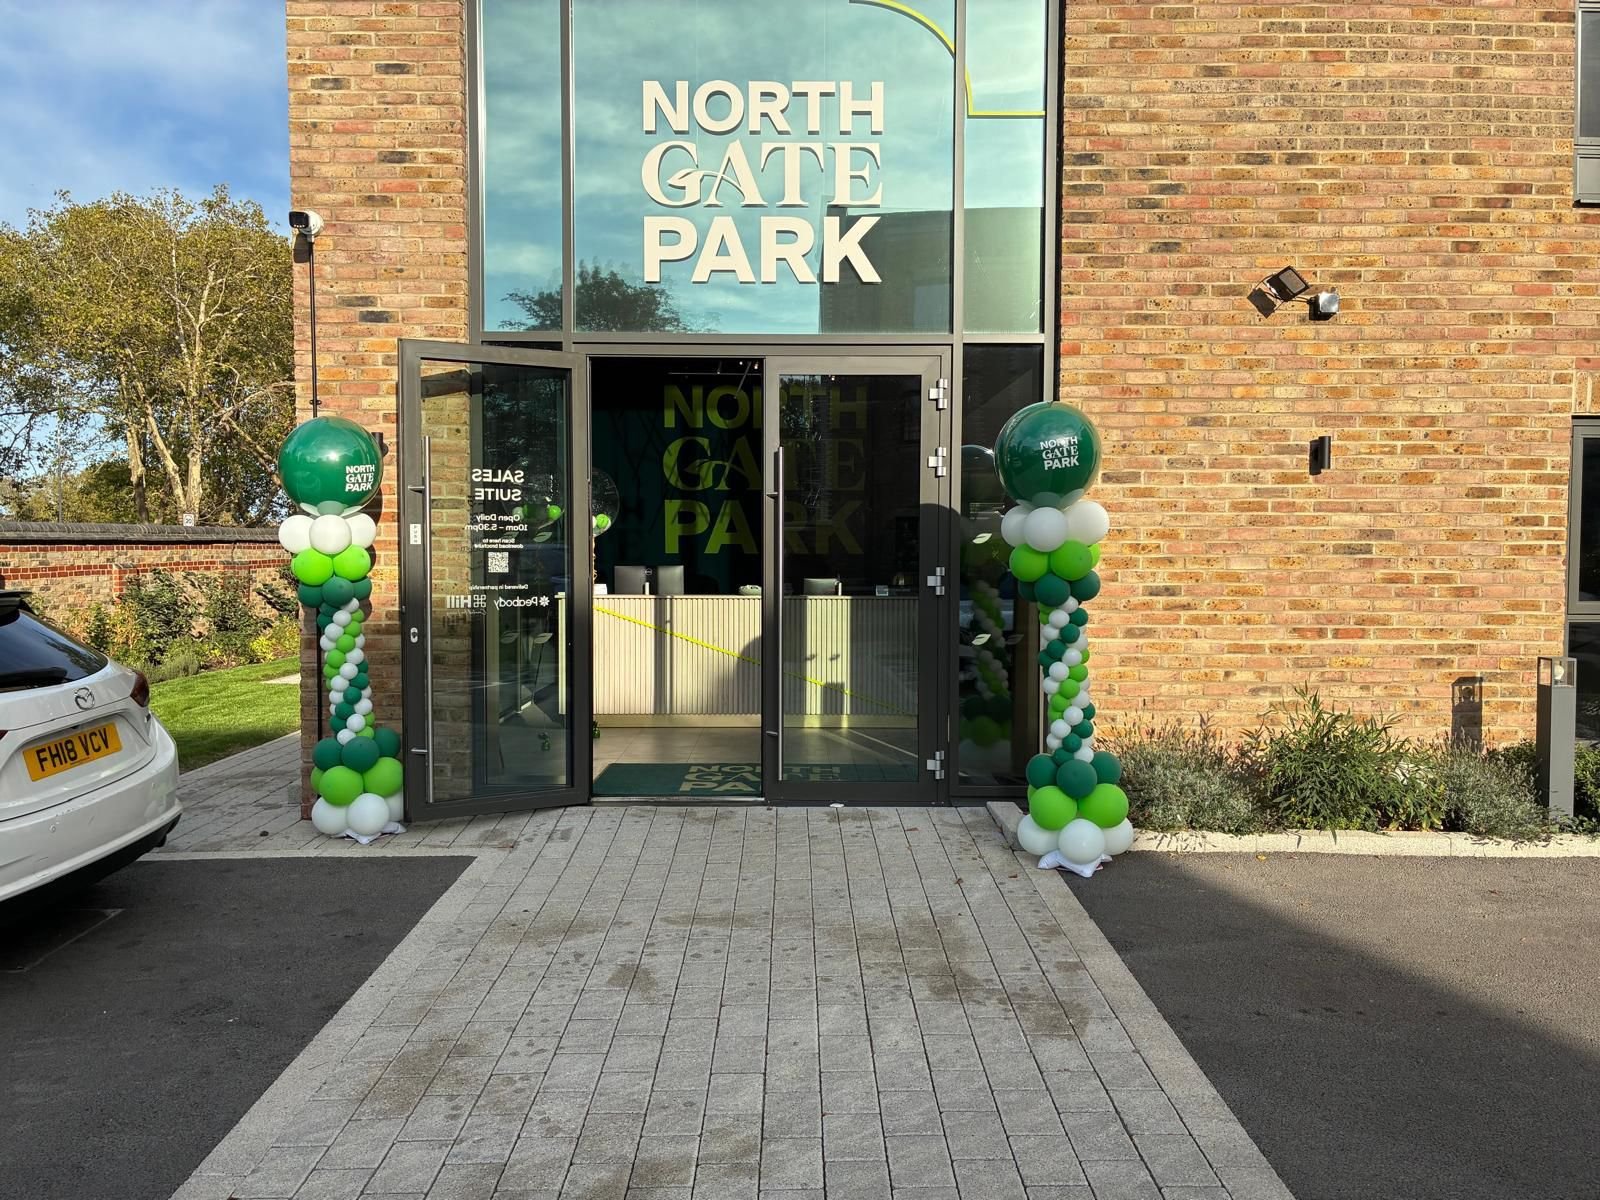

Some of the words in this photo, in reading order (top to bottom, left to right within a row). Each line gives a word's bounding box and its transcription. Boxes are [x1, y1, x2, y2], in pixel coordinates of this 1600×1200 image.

[642, 80, 885, 135] NORTH
[641, 139, 883, 208] GATE
[643, 216, 883, 284] PARK
[1040, 436, 1078, 450] NORTH
[1042, 445, 1079, 460] GATE
[345, 464, 376, 474] NORTH
[1044, 456, 1080, 471] PARK
[345, 472, 375, 483] GATE
[344, 481, 374, 492] PARK
[36, 737, 78, 772] FH18
[78, 727, 110, 756] VCV
